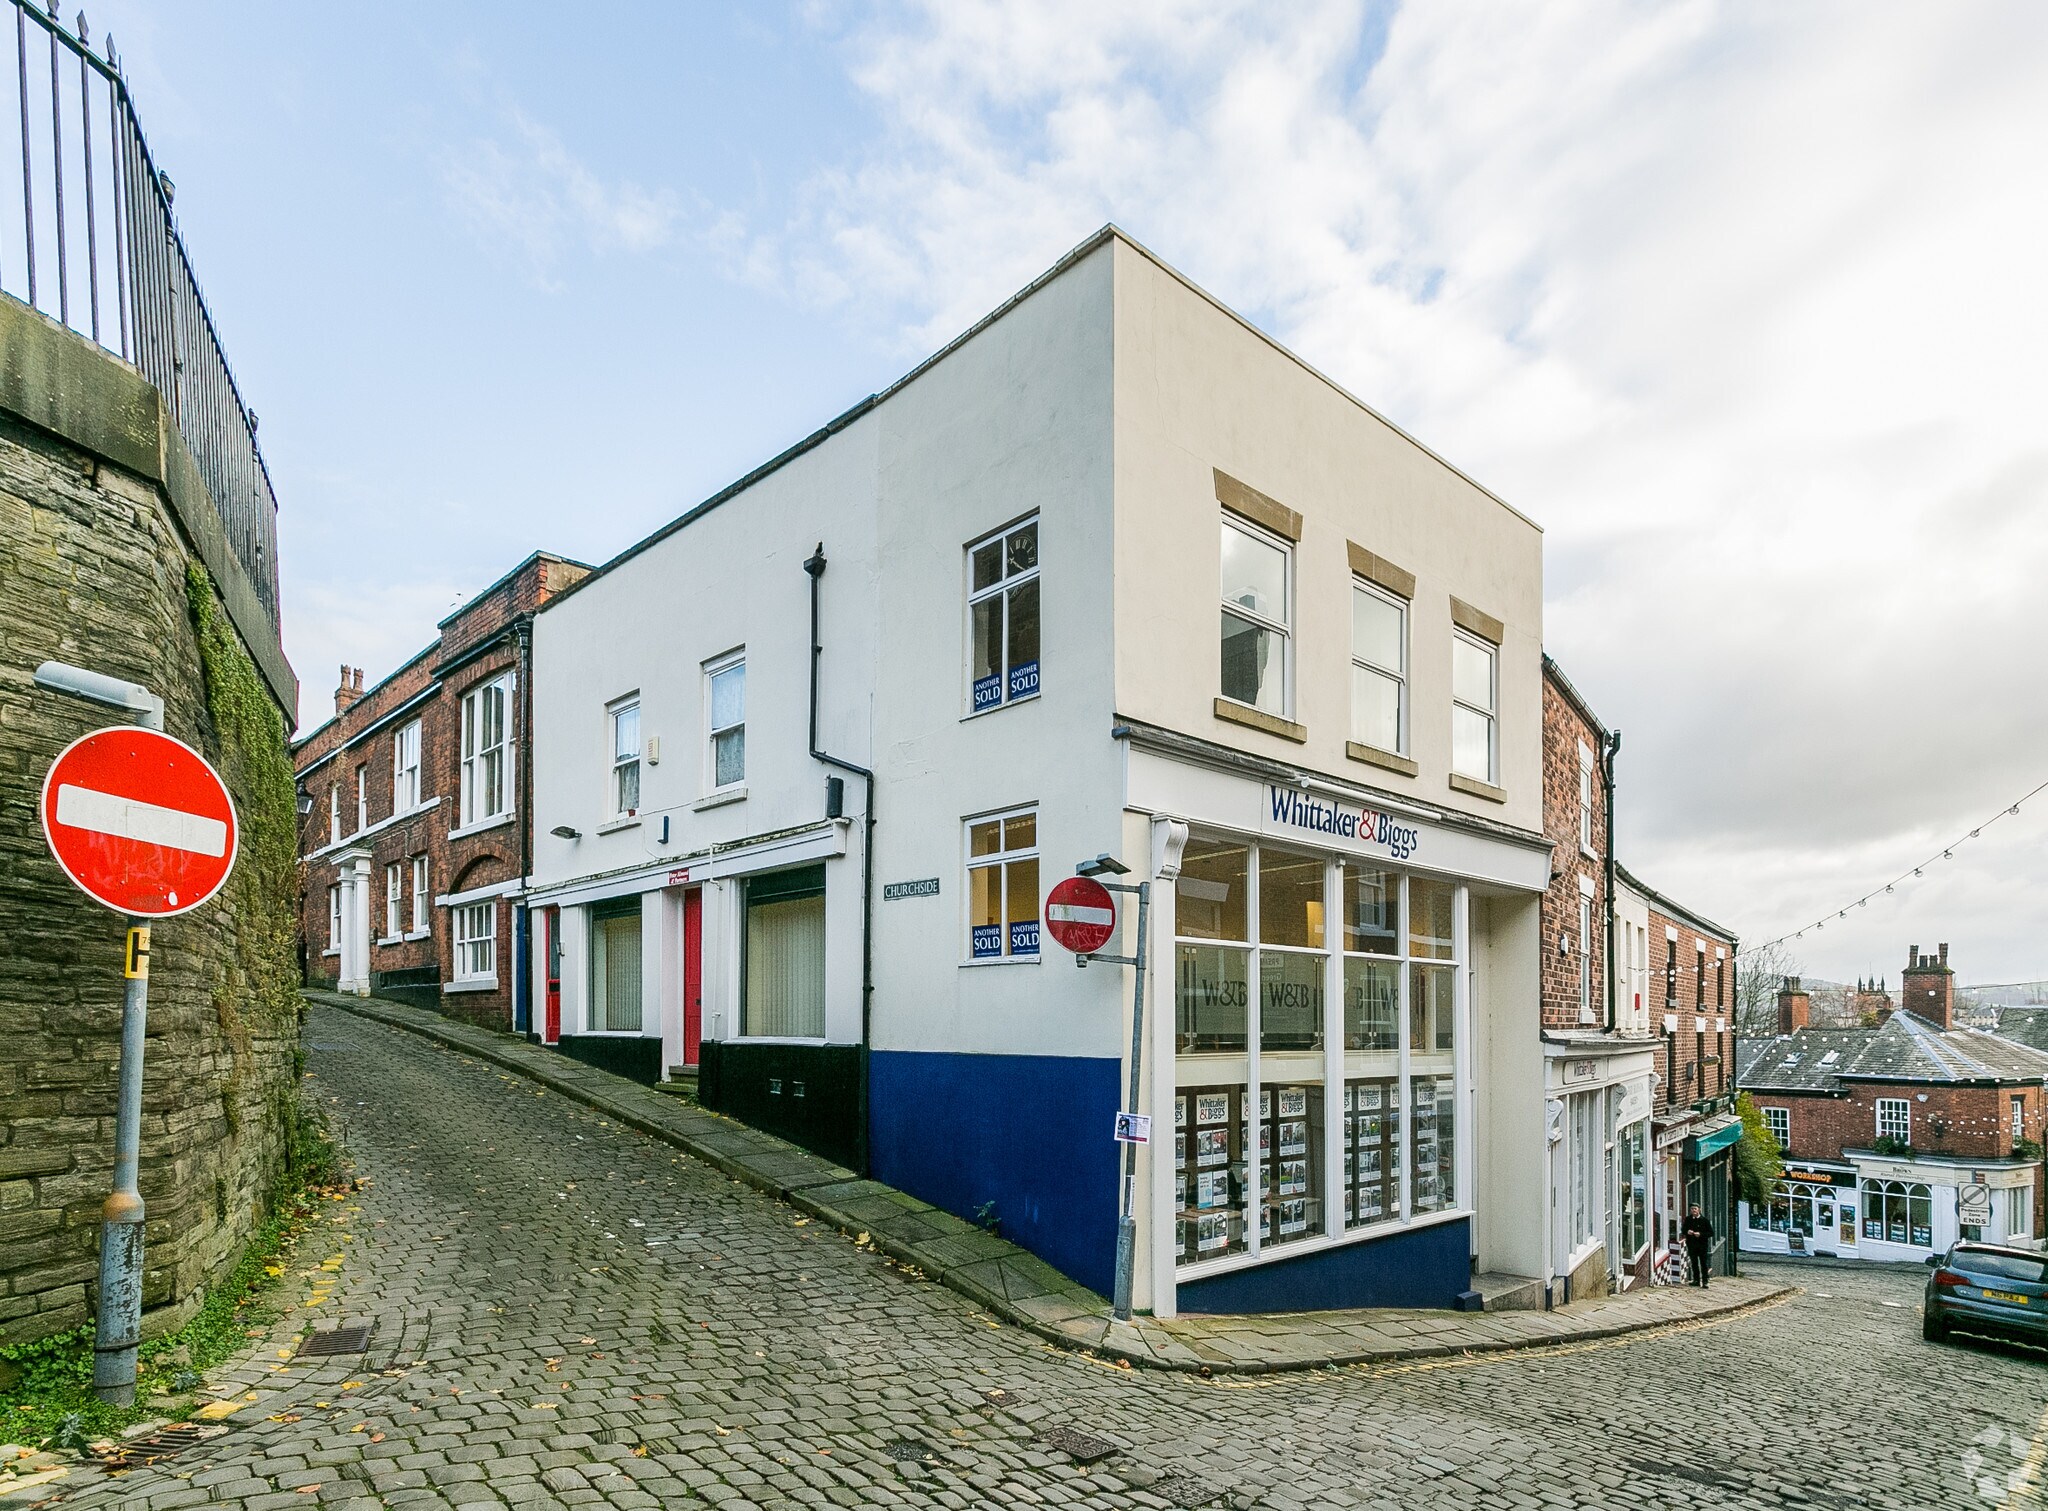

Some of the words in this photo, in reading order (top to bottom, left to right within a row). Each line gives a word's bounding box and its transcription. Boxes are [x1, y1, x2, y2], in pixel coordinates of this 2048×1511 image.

[1011, 663, 1038, 679] ANOTHER
[975, 677, 1000, 691] ANOTHER
[1011, 673, 1039, 694] SOLD
[975, 685, 1000, 705] SOLD
[885, 880, 938, 898] CHURCHSIDE
[974, 927, 1000, 937] ANOTHER
[1011, 924, 1039, 934] ANOTHER
[974, 936, 1000, 951] SOLD
[1012, 933, 1039, 948] SOLD
[1202, 979, 1249, 1008] W&B
[1269, 982, 1310, 1008] W&B
[1790, 1171, 1832, 1183] WORKSHOP
[1963, 1217, 1987, 1225] ENDS
